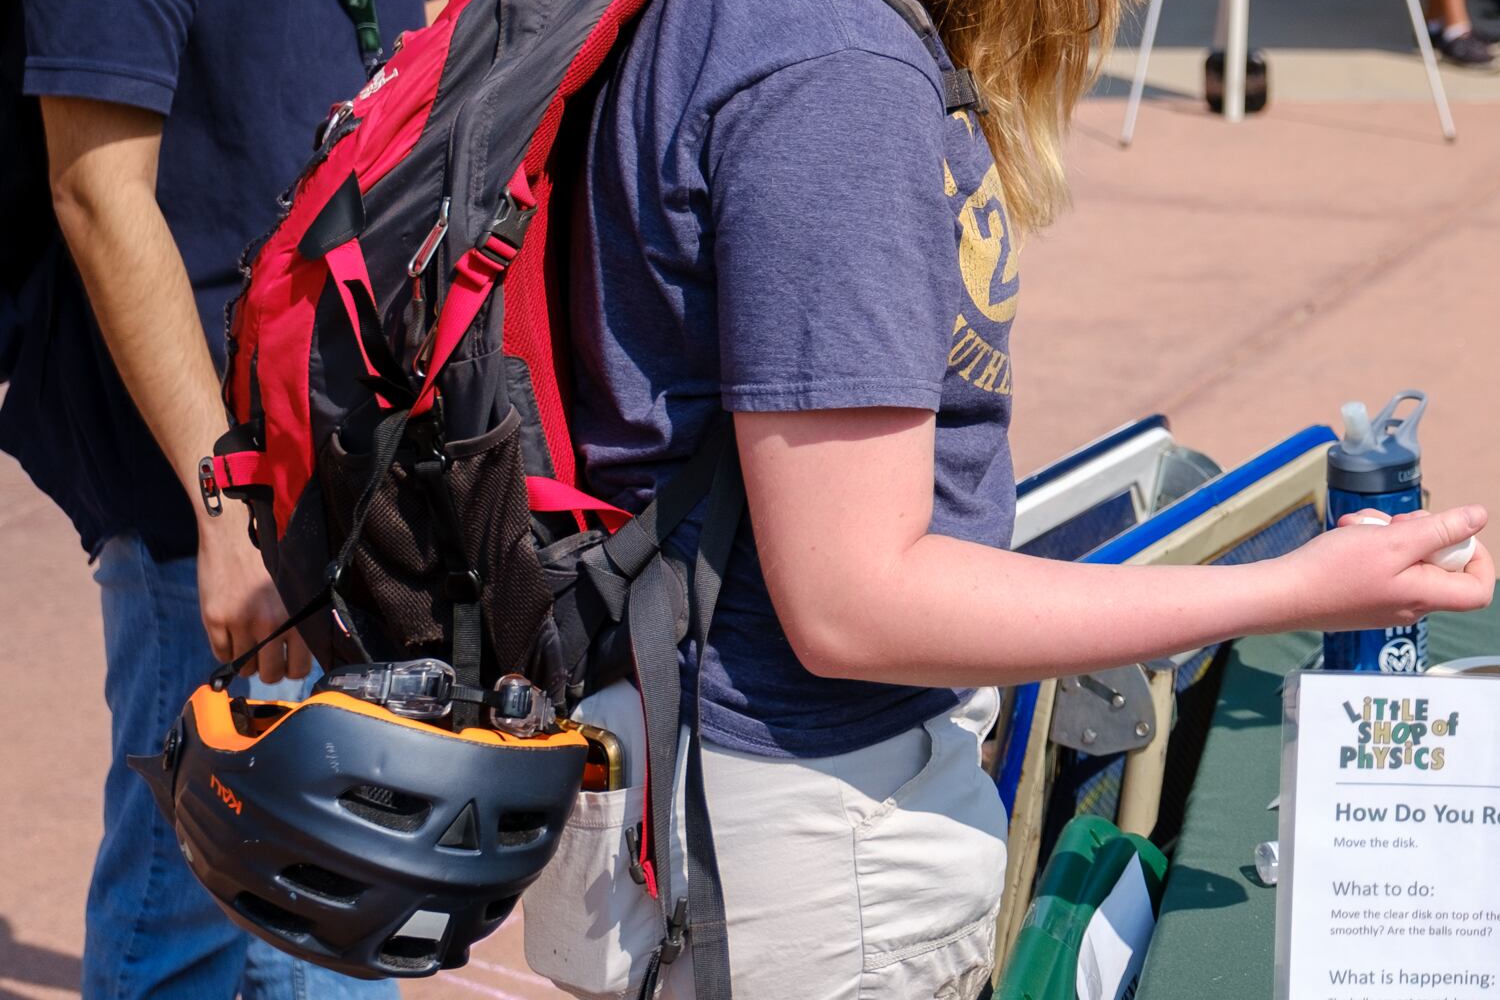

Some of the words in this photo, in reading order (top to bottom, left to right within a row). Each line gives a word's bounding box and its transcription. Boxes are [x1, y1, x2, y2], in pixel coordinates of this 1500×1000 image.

[1358, 721, 1427, 746] SHOP
[1431, 711, 1459, 737] of
[210, 774, 242, 816] KALI
[1336, 803, 1388, 822] How
[1395, 804, 1426, 823] Do
[1434, 804, 1475, 824] You
[1334, 837, 1366, 848] Move
[1370, 837, 1389, 848] the
[1393, 837, 1418, 848] disk.
[1332, 881, 1379, 897] What
[1384, 883, 1402, 897] to
[1407, 881, 1435, 897] do:
[1331, 909, 1360, 920] Move
[1363, 909, 1380, 920] the
[1383, 910, 1409, 920] clear
[1412, 910, 1432, 920] disk
[1435, 912, 1448, 920] on
[1452, 911, 1469, 922] top
[1472, 910, 1484, 921] of
[1330, 925, 1384, 937] smoothly?
[1387, 926, 1405, 935] Are
[1408, 926, 1426, 936] the
[1429, 926, 1453, 936] balls
[1455, 926, 1493, 936] round?
[1329, 969, 1376, 985] What
[1381, 969, 1394, 985] is
[1399, 969, 1496, 989] happening:
